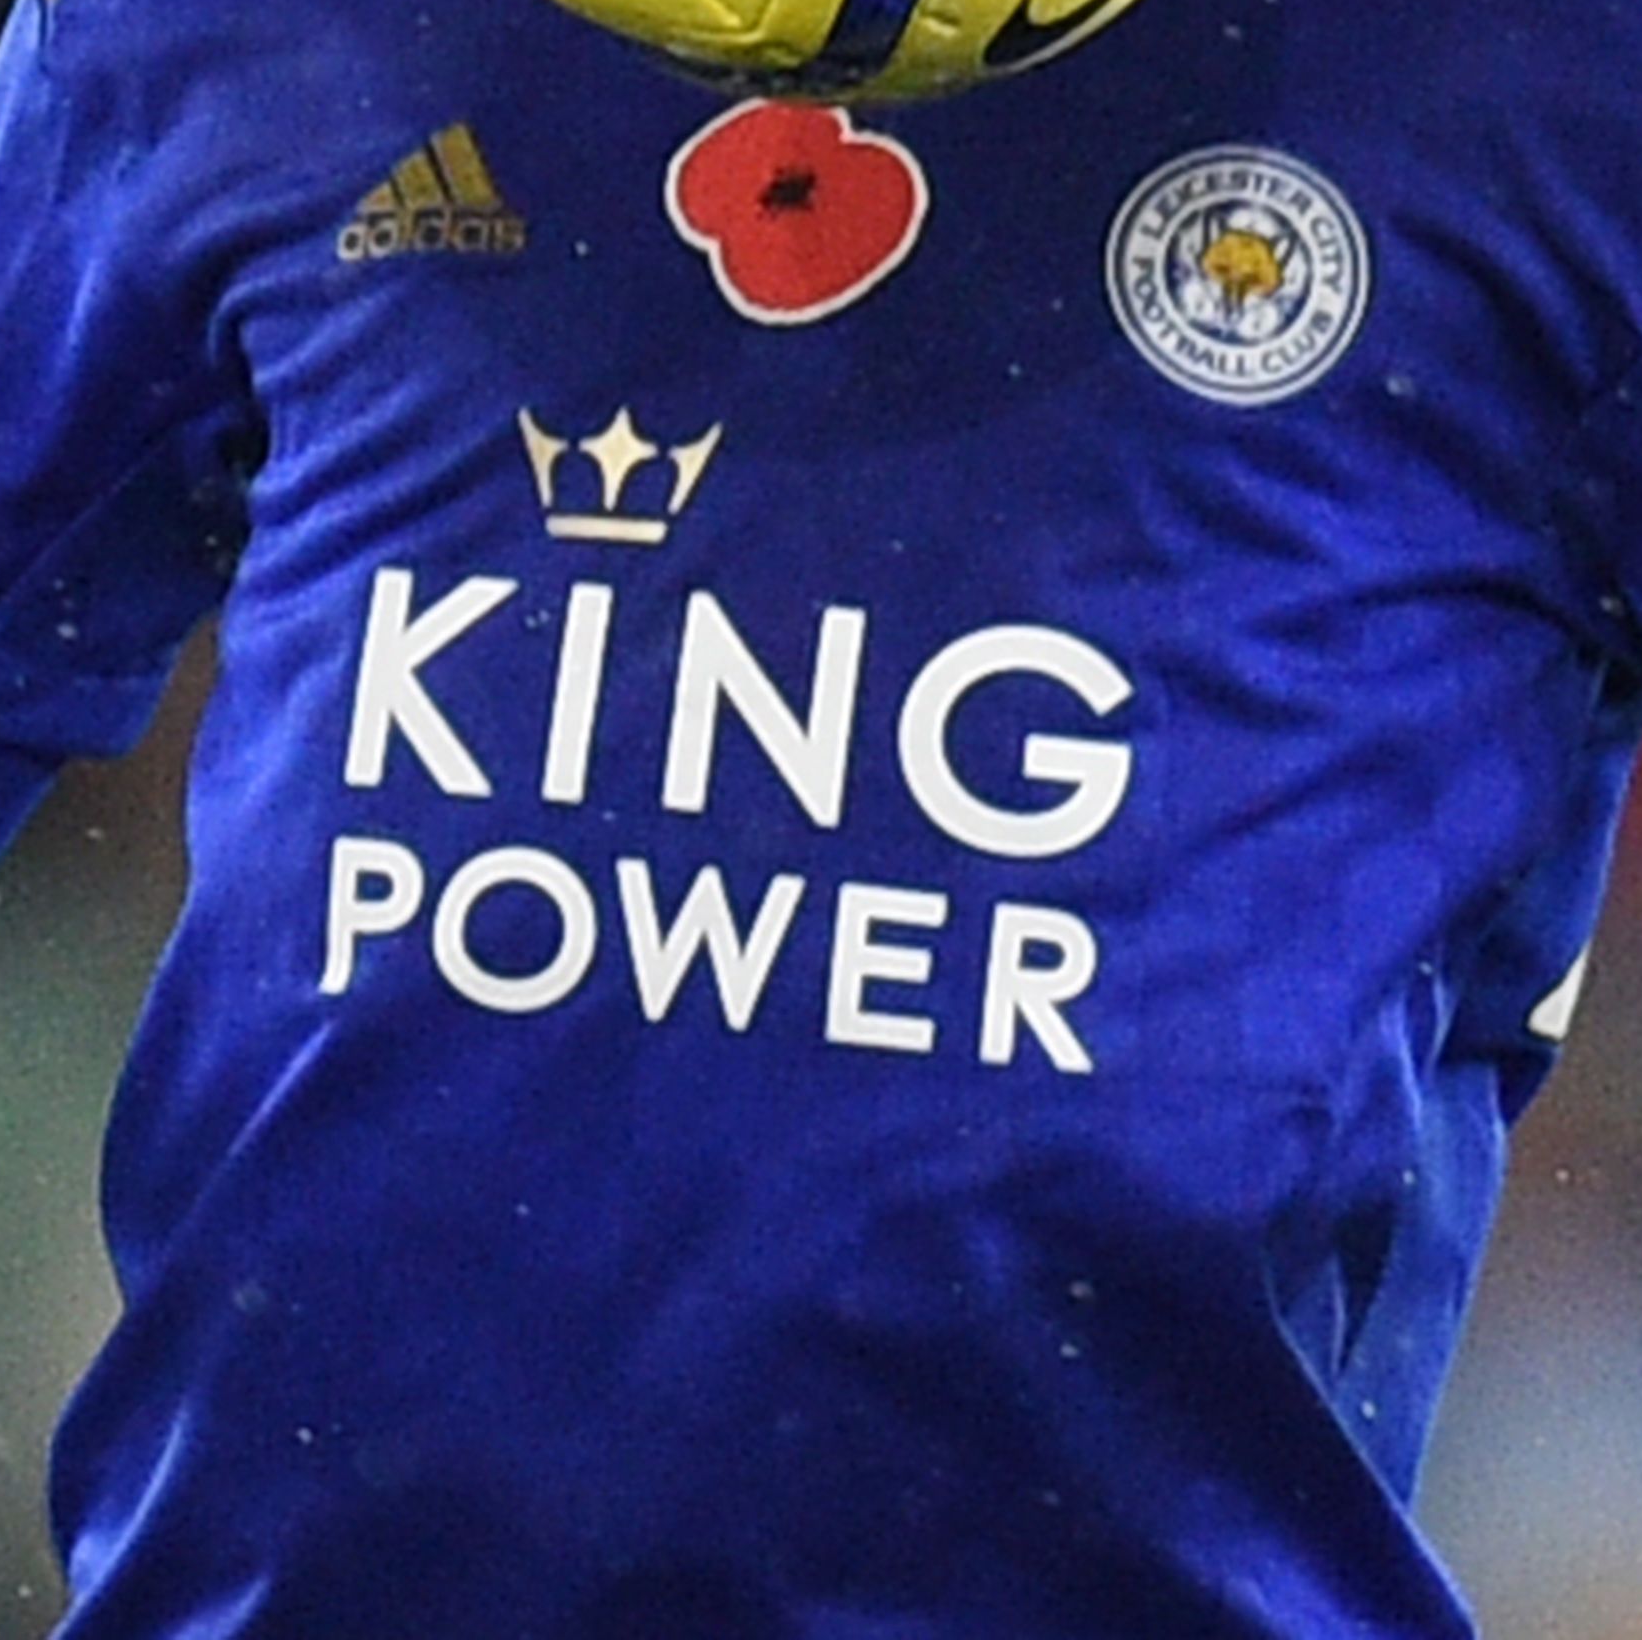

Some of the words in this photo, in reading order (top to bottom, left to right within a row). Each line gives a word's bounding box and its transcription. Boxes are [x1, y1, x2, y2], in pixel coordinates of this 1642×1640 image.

[336, 207, 525, 261] adidas
[1141, 169, 1313, 242] LEICESTER
[1308, 215, 1346, 295] CITY
[1260, 309, 1333, 375] CLUB
[343, 566, 1134, 859] KING
[319, 835, 1098, 1074] POWER
